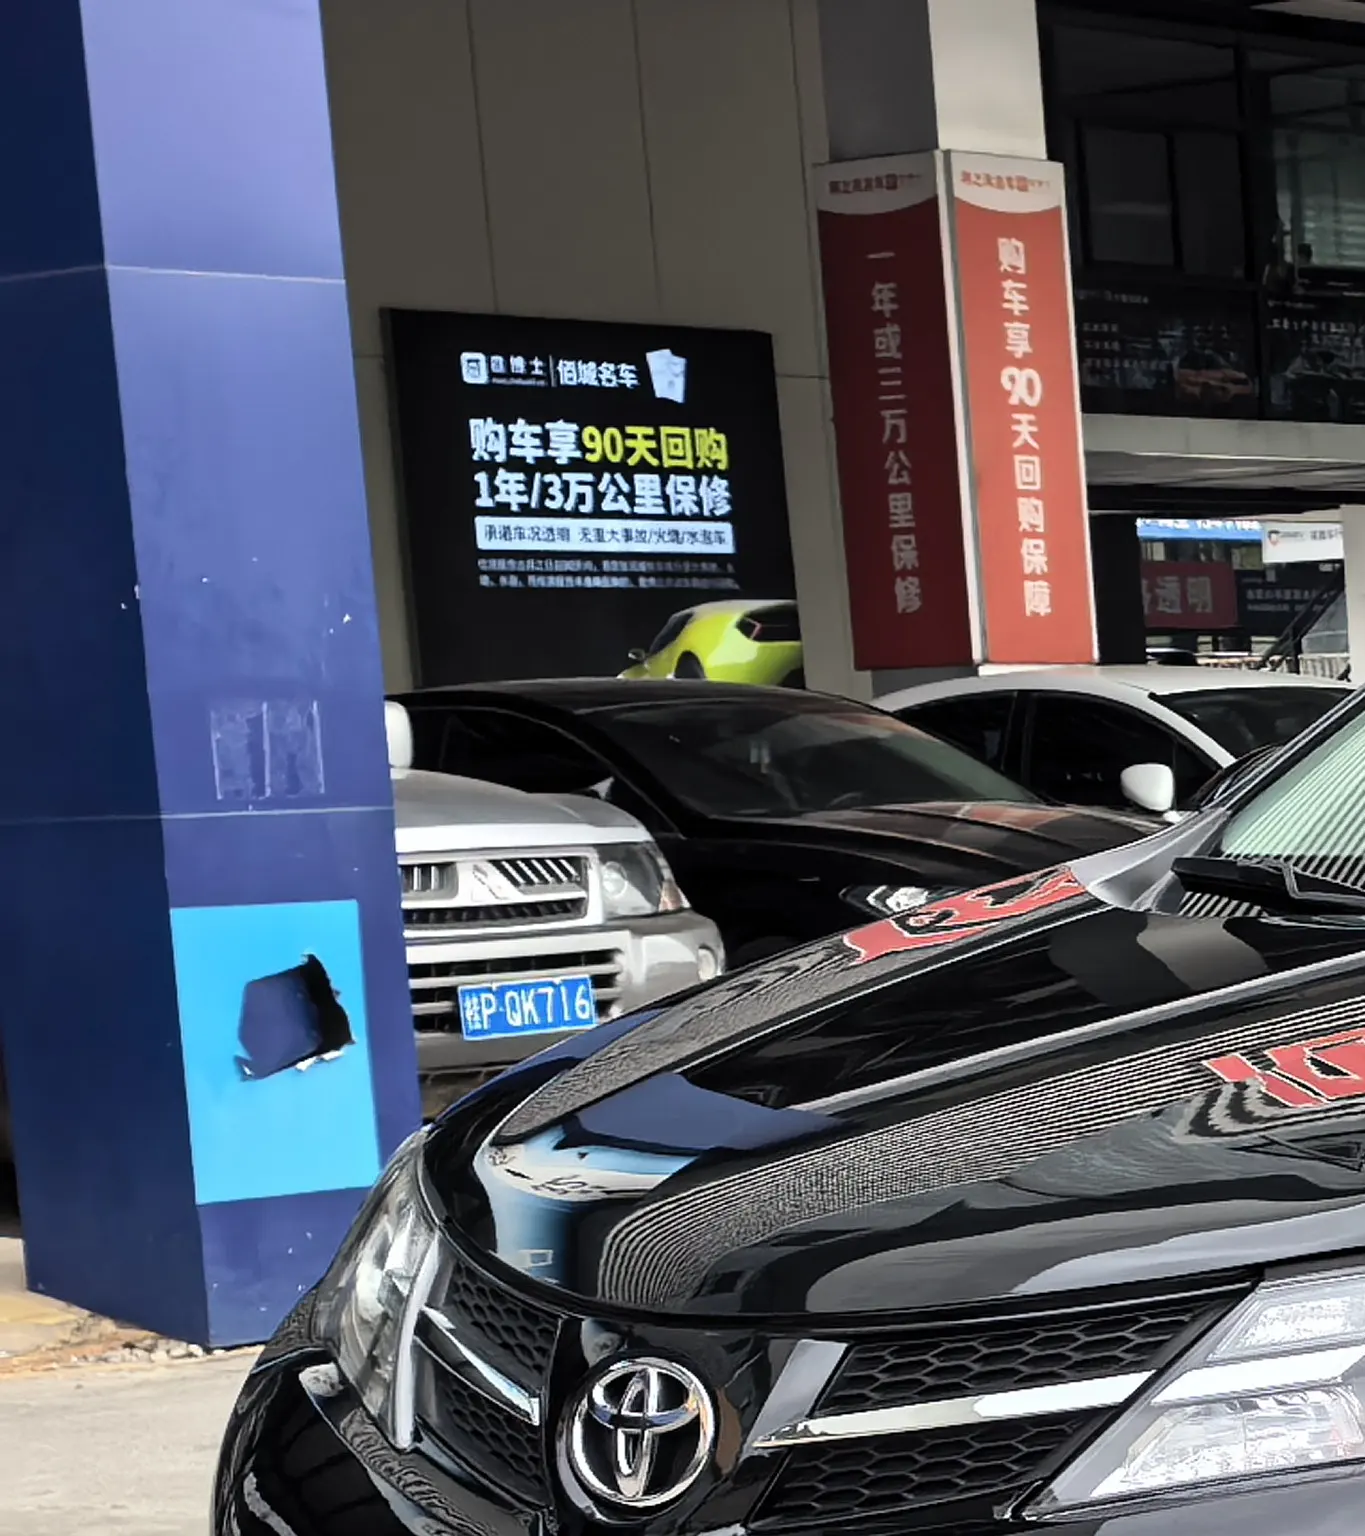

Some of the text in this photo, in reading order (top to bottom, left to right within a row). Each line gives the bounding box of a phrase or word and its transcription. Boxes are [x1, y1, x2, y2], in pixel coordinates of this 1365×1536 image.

[468, 417, 730, 471] 购车享90天回购
[473, 470, 733, 517] 1年/3万公里保修
[866, 250, 922, 614] 一年或三万公里保修
[996, 237, 1052, 617] 购车享90天回购保障
